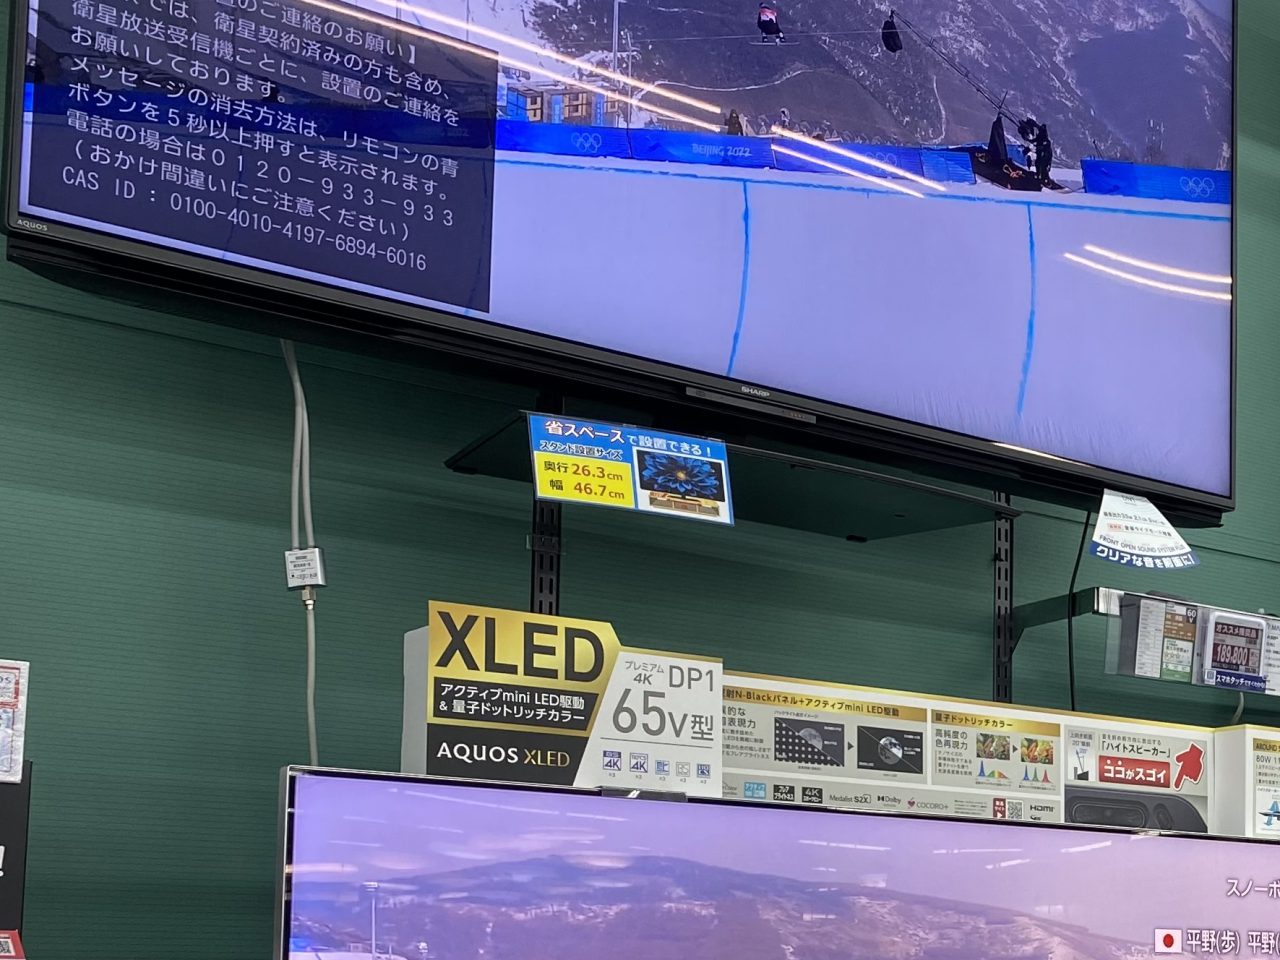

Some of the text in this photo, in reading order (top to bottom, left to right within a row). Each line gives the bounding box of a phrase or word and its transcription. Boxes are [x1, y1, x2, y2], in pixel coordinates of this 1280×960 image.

[70, 25, 290, 104] お願いしております。
[70, 56, 460, 179] メッセージの消去方法は、リモコンの青
[67, 82, 447, 201] ボタンを5秒以上押すと表示されます。
[726, 146, 752, 157] 2022
[16, 218, 49, 232] AQUOS
[62, 165, 428, 273] CAS ID 0100-4010-4197-6894-6016
[741, 385, 771, 398] SHARP
[545, 420, 711, 458] 省スペースで設置できる!
[539, 439, 623, 460] スタンド設置サイズ
[549, 479, 625, 500] 幅 46.7cm
[1100, 534, 1137, 551] FRONT OPEN
[1187, 609, 1197, 618] 60
[435, 610, 605, 685] XLED
[1216, 647, 1248, 665] 189,800
[625, 659, 665, 675] プレミアム
[633, 671, 653, 686] 4K
[668, 664, 715, 692] DP1
[440, 682, 585, 710] アクティブmini LED駆動
[439, 699, 586, 723] & 量子ドットリッチカラー
[935, 712, 1013, 728] 量子ドットリッチカラー
[935, 728, 968, 740] 高純度の
[935, 739, 968, 751] 色再現力
[1101, 741, 1171, 758] 「ハイトスピーカー」
[1255, 742, 1278, 752] AROUND
[437, 741, 571, 769] AQUOS XLED
[1256, 755, 1271, 765] 80W
[1103, 762, 1166, 784] ココがスゴイ
[1186, 929, 1240, 955] 平野(歩)
